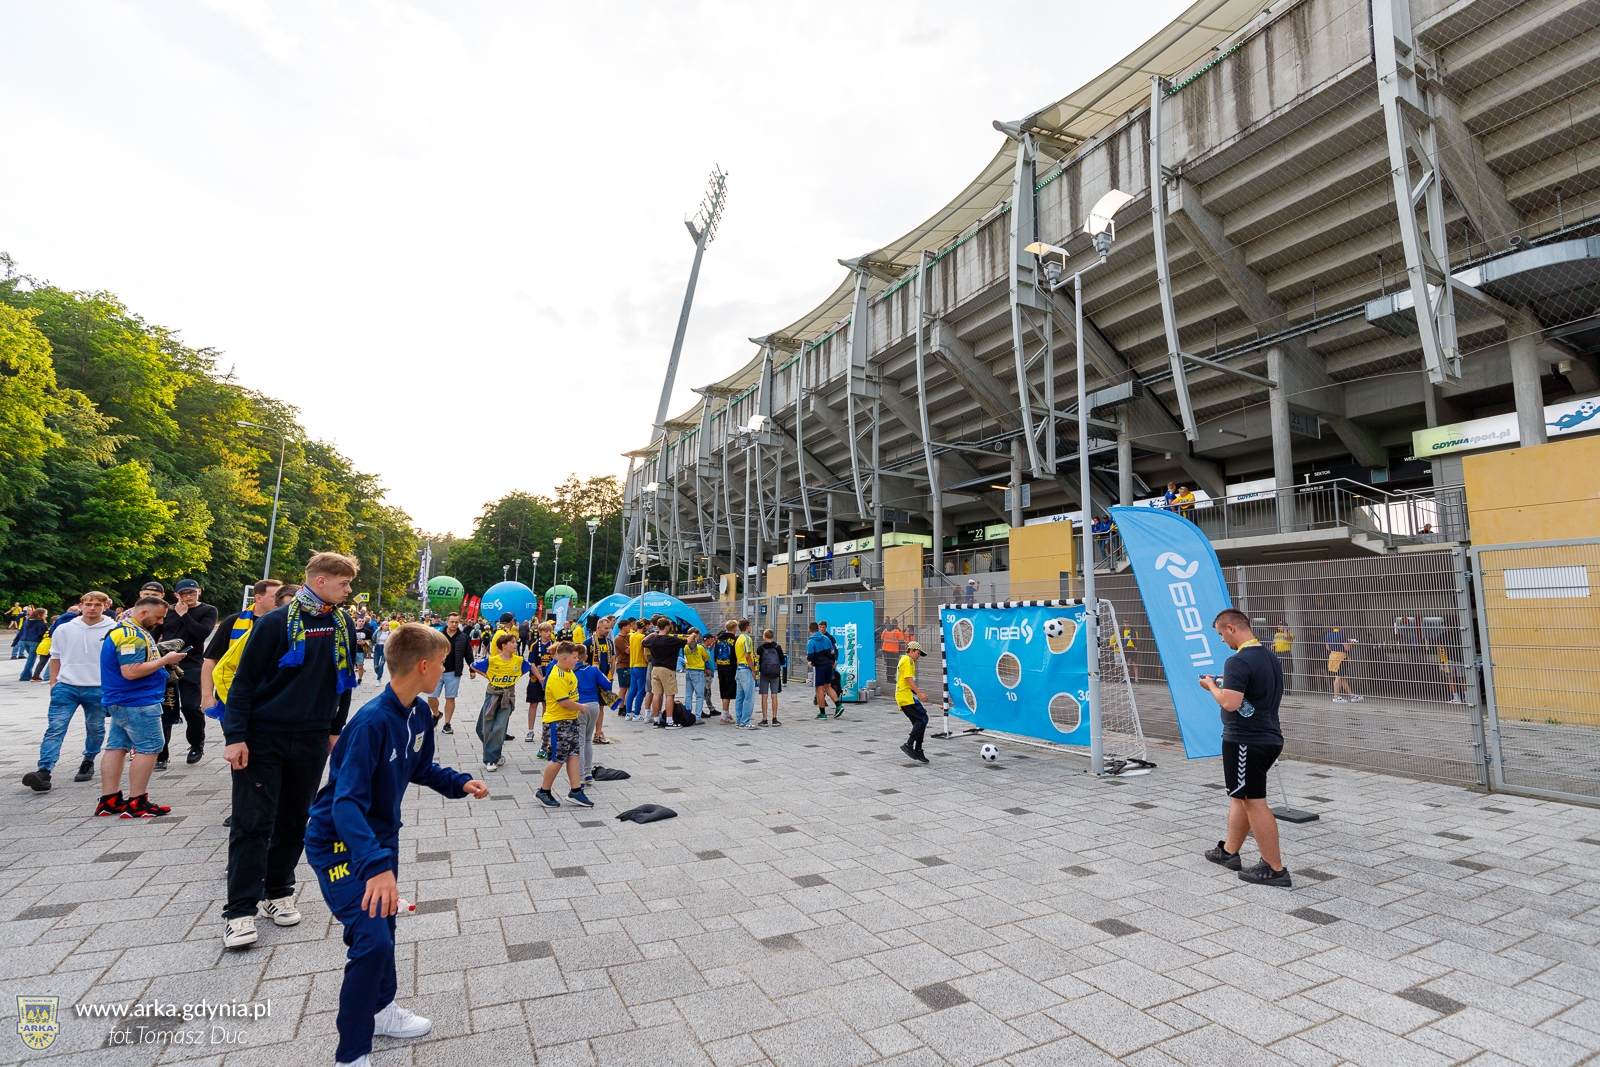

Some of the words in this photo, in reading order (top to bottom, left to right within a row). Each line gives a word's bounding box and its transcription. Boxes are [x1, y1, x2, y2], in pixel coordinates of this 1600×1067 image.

[1291, 412, 1300, 424] 21
[974, 528, 984, 538] 22
[946, 614, 956, 623] 50
[491, 674, 518, 683] forBET
[1005, 691, 1018, 702] 10
[333, 841, 347, 854] H
[328, 862, 351, 883] HK
